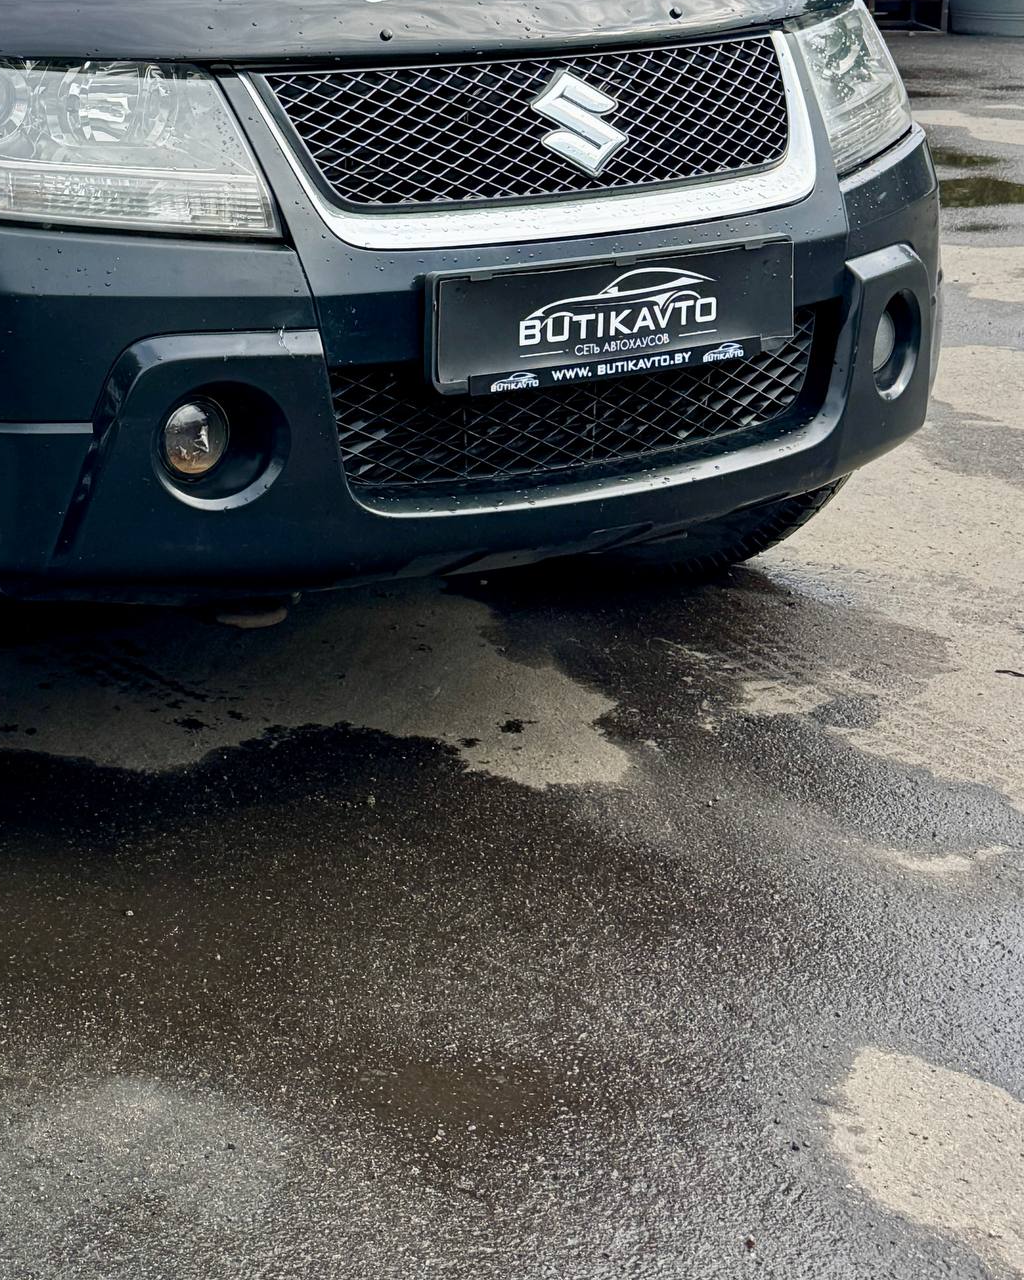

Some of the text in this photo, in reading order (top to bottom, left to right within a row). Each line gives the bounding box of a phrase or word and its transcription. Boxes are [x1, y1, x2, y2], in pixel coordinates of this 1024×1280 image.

[519, 297, 717, 346] BUTIKAVTO
[574, 333, 670, 356] СЕТЬ АВТОХАУСОВ
[702, 349, 744, 363] BUTIKAVTO
[551, 352, 692, 381] WWW. BUTIKAVTO.BY
[490, 379, 539, 392] BUTIKAVTO
